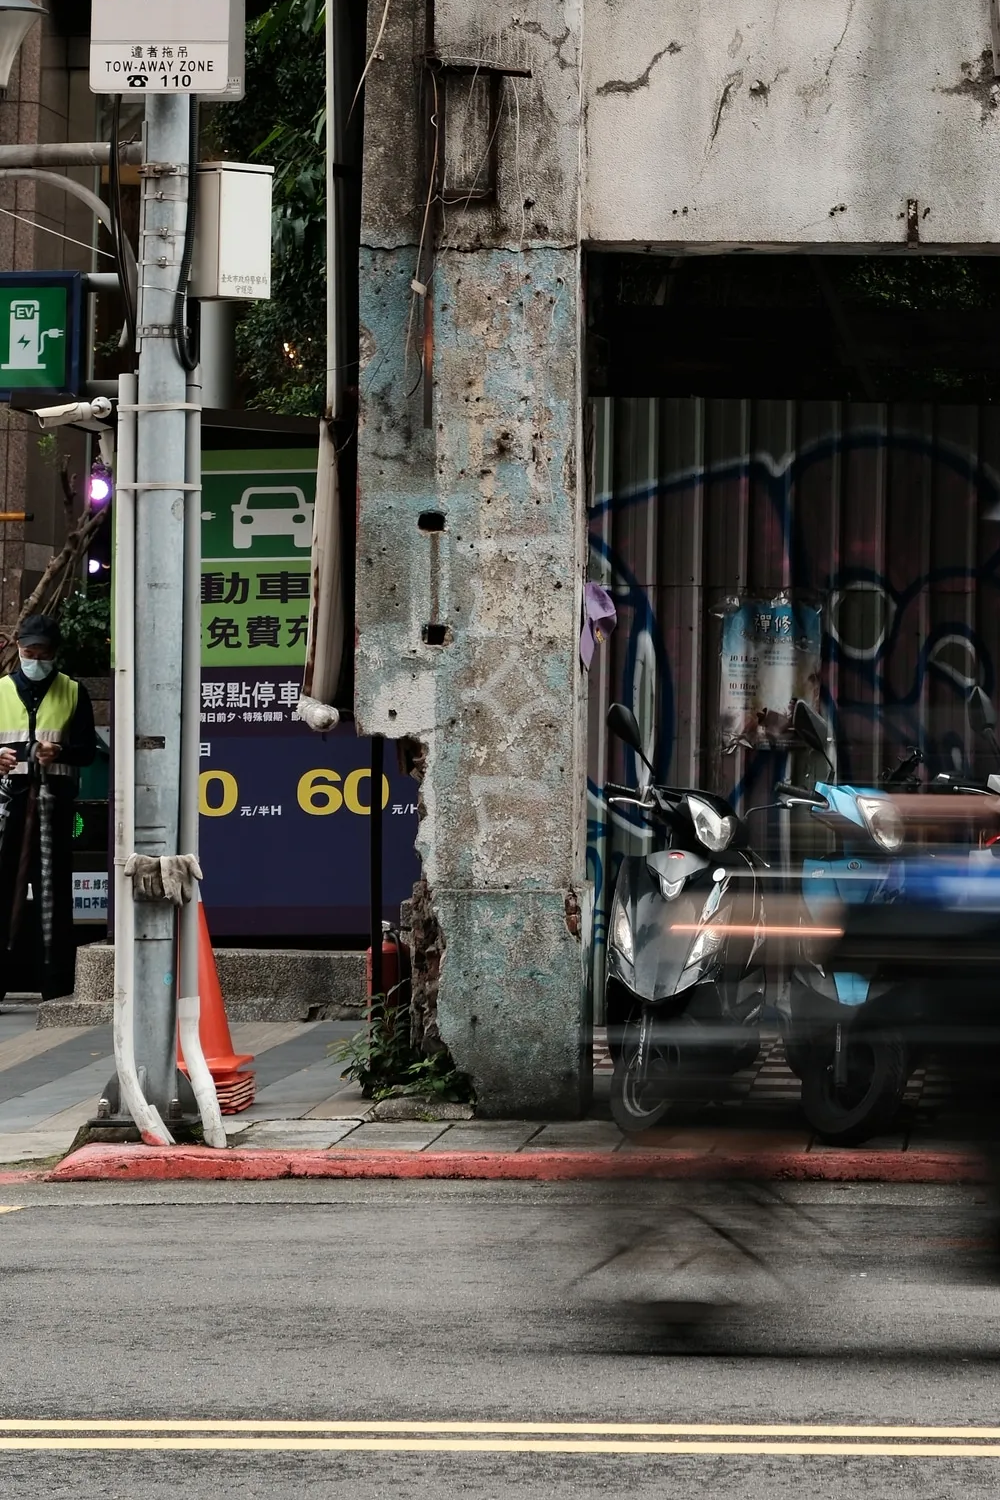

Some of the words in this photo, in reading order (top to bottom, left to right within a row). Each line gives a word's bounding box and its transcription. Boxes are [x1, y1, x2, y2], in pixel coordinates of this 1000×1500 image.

[131, 46, 188, 58] 違者拖吊
[105, 61, 174, 72] TOW-AWAY
[179, 60, 214, 72] ZONE
[160, 75, 192, 87] 110
[16, 307, 34, 318] EV
[200, 571, 311, 604] 動車
[200, 615, 309, 649] 免費充
[201, 681, 300, 708] 聚點停車
[297, 768, 390, 815] 60
[240, 804, 282, 817] 元/半H
